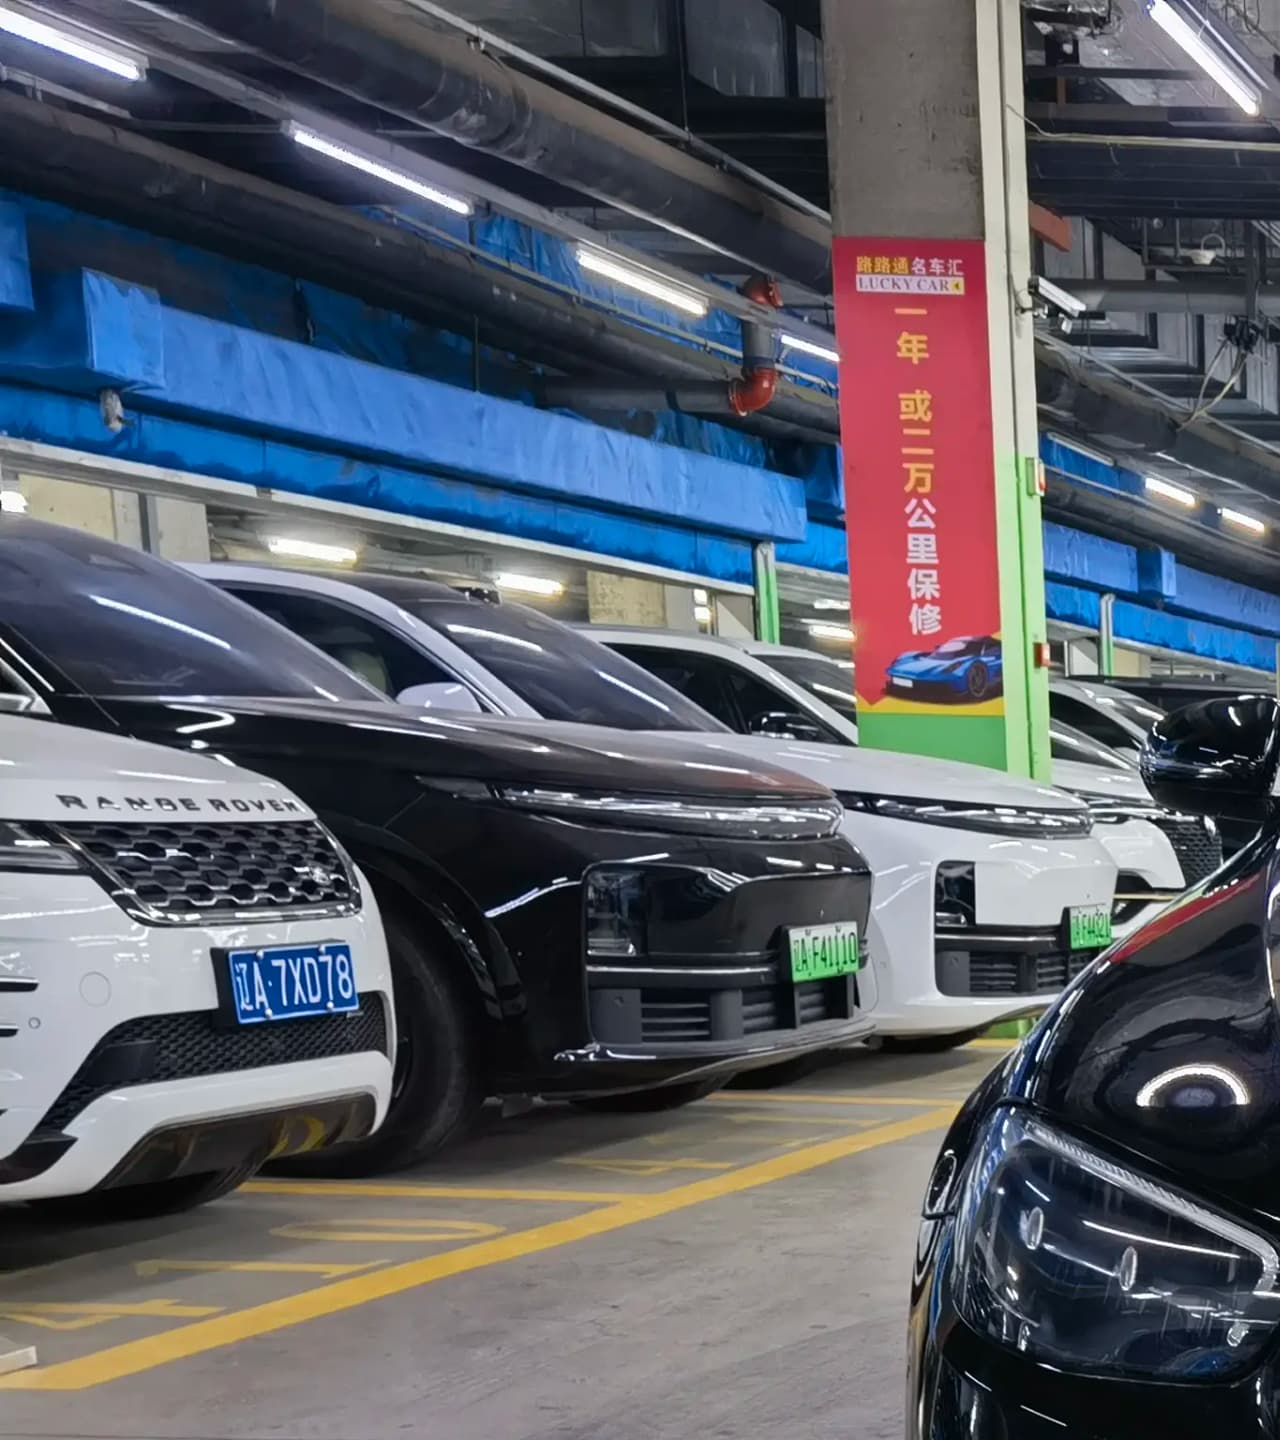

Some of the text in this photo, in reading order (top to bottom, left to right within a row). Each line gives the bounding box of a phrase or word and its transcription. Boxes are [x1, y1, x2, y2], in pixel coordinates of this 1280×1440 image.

[856, 256, 964, 276] 路路通名车汇
[858, 277, 949, 292] LUCKY CAR
[56, 795, 201, 812] RANGE
